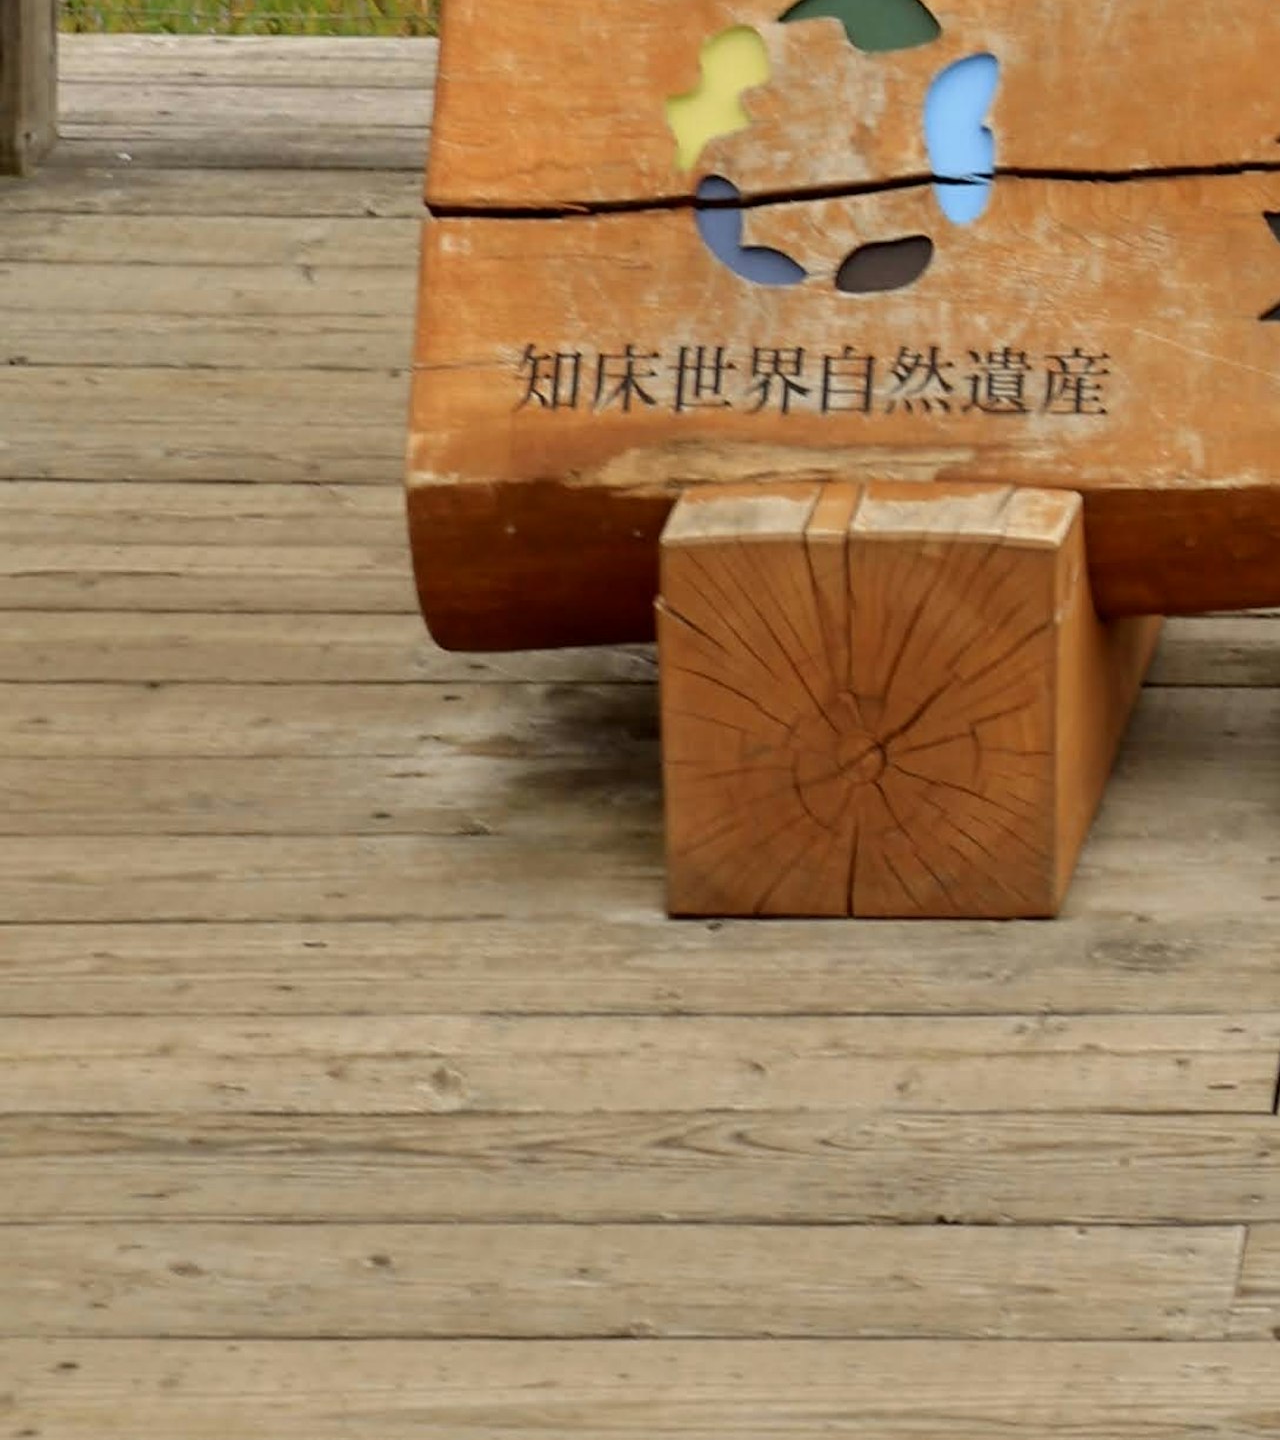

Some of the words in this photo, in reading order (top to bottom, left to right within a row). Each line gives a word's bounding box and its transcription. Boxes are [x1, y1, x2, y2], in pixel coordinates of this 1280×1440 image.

[513, 343, 1112, 418] 知床世界自然遺産
